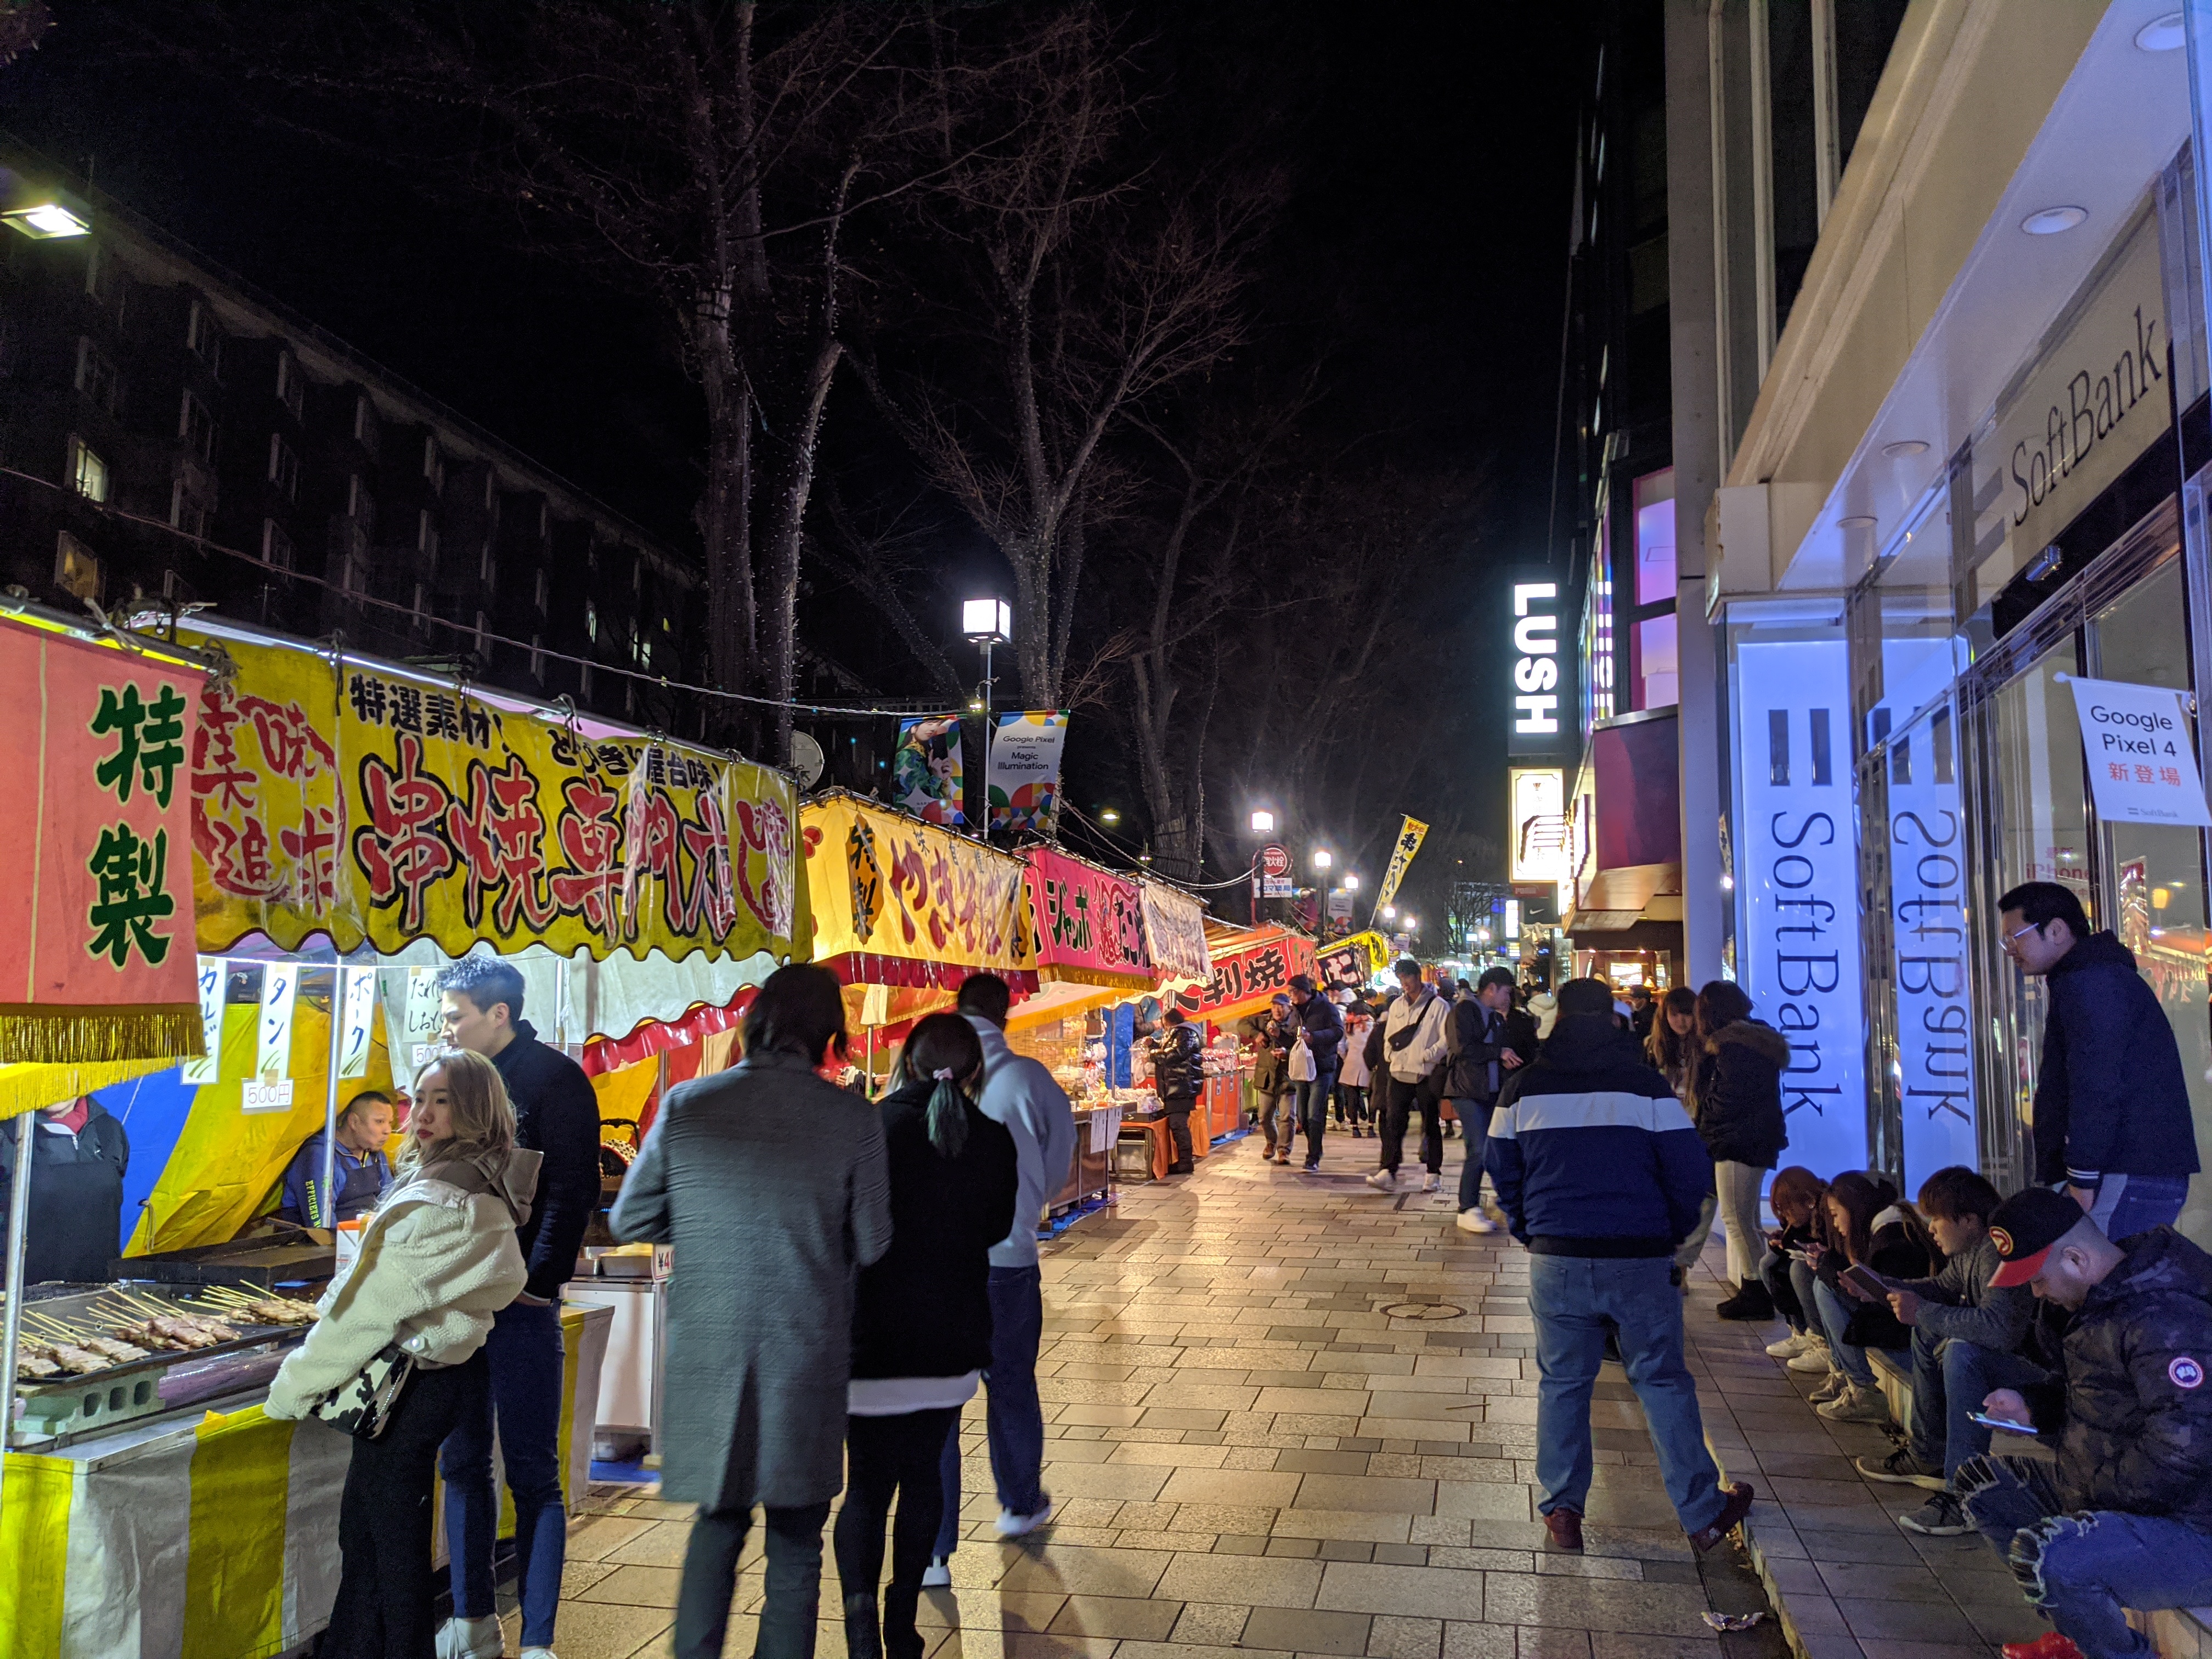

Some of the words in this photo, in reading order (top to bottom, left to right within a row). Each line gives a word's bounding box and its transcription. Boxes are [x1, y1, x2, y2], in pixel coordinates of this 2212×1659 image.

[2011, 303, 2162, 527] SoftBank
[1514, 582, 1558, 733] LUSH
[1003, 735, 1034, 744] Google
[1035, 736, 1055, 744] Pixel
[2091, 706, 2173, 732] Google
[997, 761, 1049, 770] Illumination
[1011, 752, 1039, 761] Magic
[2102, 733, 2157, 755] Pixel
[2164, 741, 2177, 757] 4
[2108, 761, 2181, 787] 新登場
[88, 679, 188, 971] 特製
[2141, 808, 2179, 818] SoftBank
[889, 837, 1003, 956] やきそば
[1045, 878, 1094, 953] ジャンボ
[1770, 811, 1842, 1118] SoftBank
[268, 977, 287, 1045] タン
[349, 973, 374, 1056] ポーク
[247, 1082, 290, 1105] 500円
